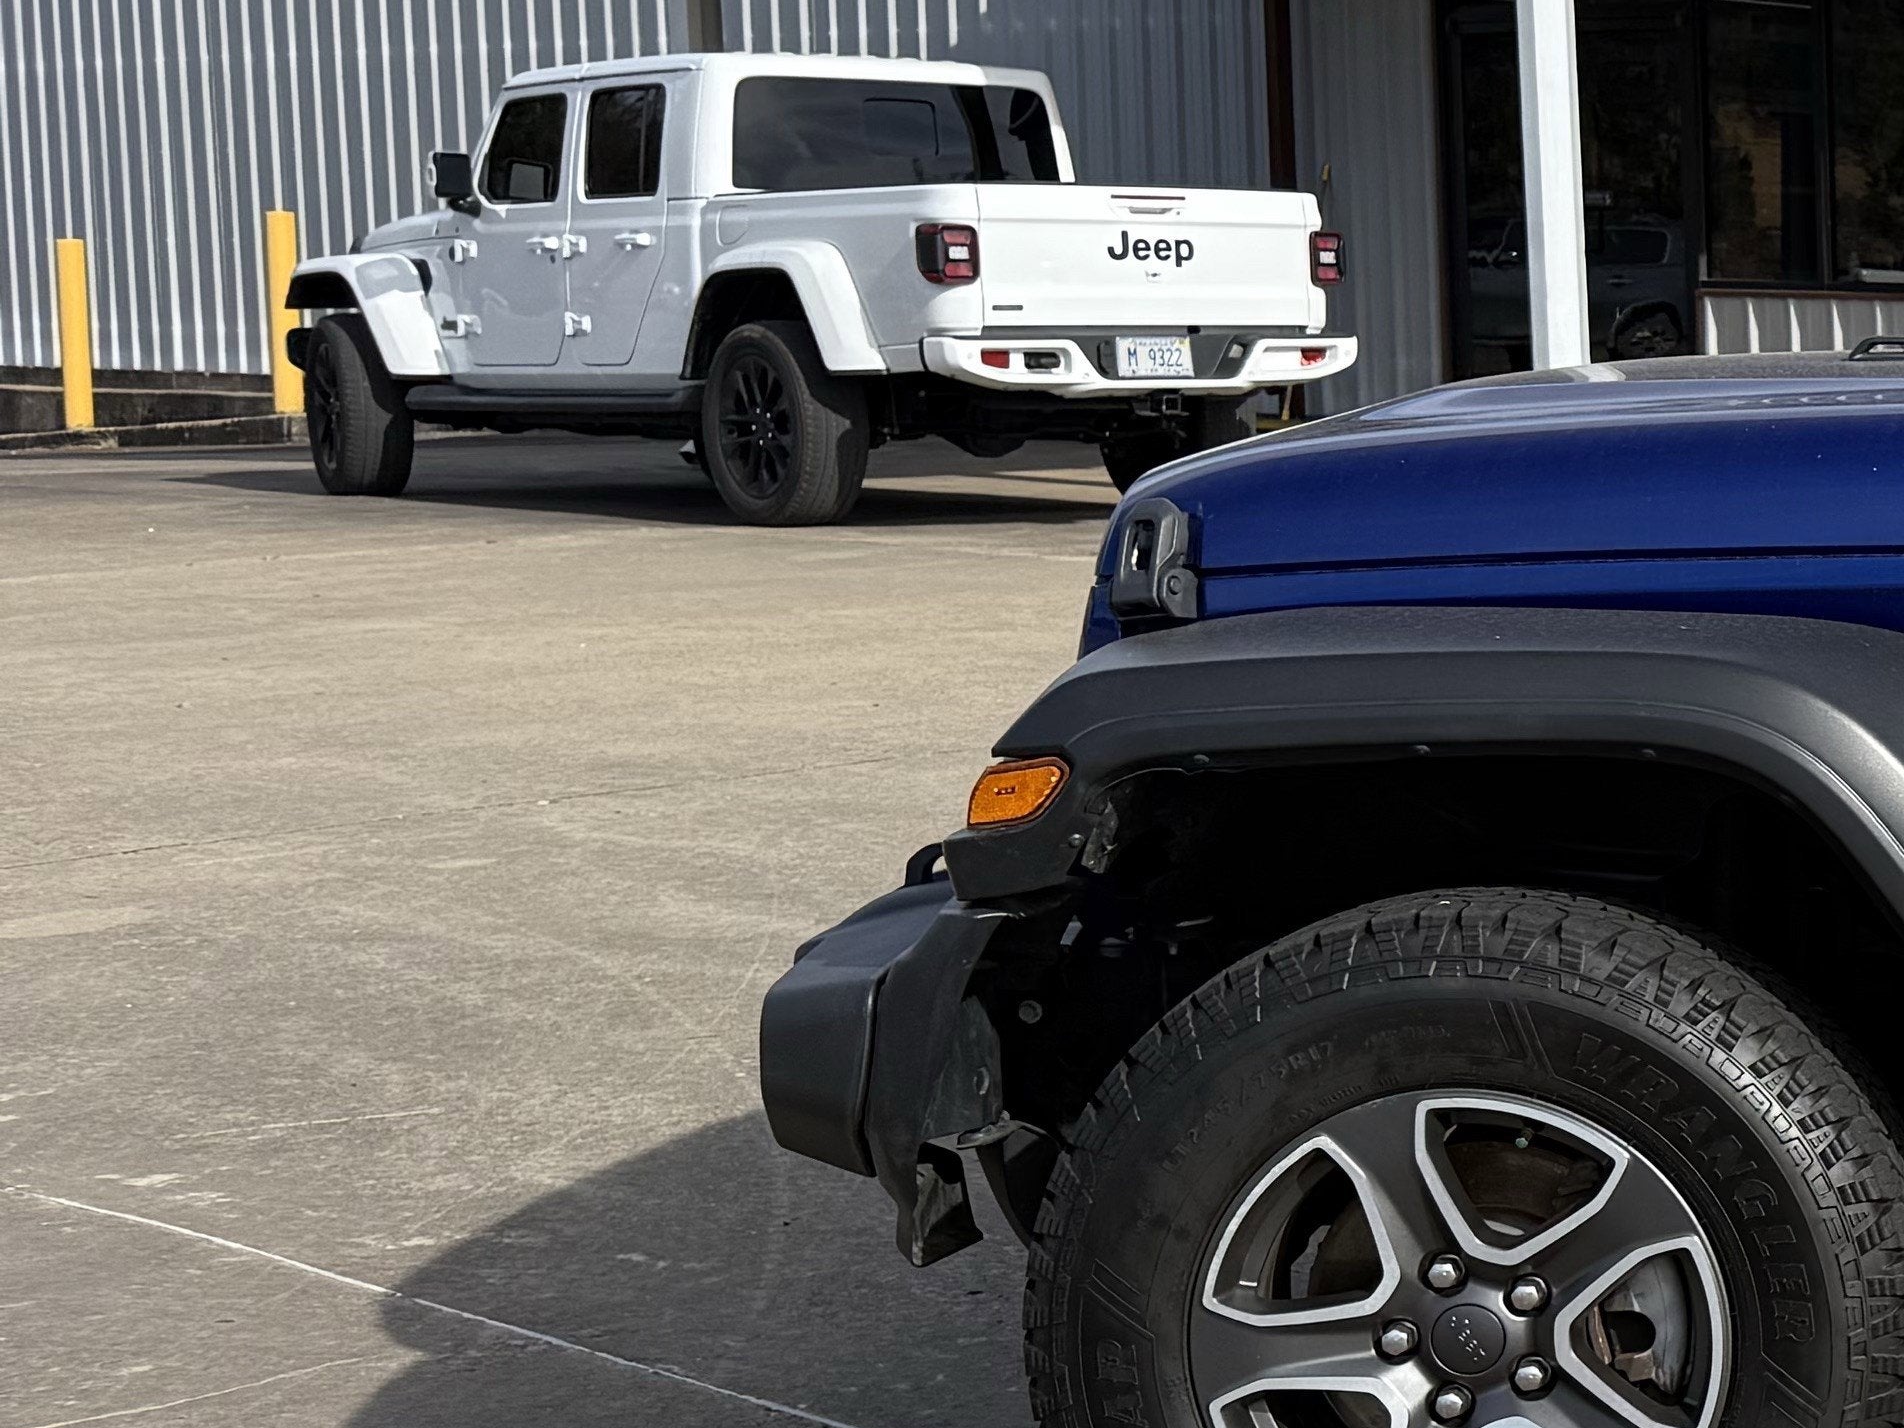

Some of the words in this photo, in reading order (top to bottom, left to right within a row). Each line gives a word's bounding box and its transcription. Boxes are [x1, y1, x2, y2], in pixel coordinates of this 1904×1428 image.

[1107, 230, 1194, 267] Jeep
[1148, 347, 1184, 367] 9322
[1569, 1032, 1817, 1348] WRANGLER
